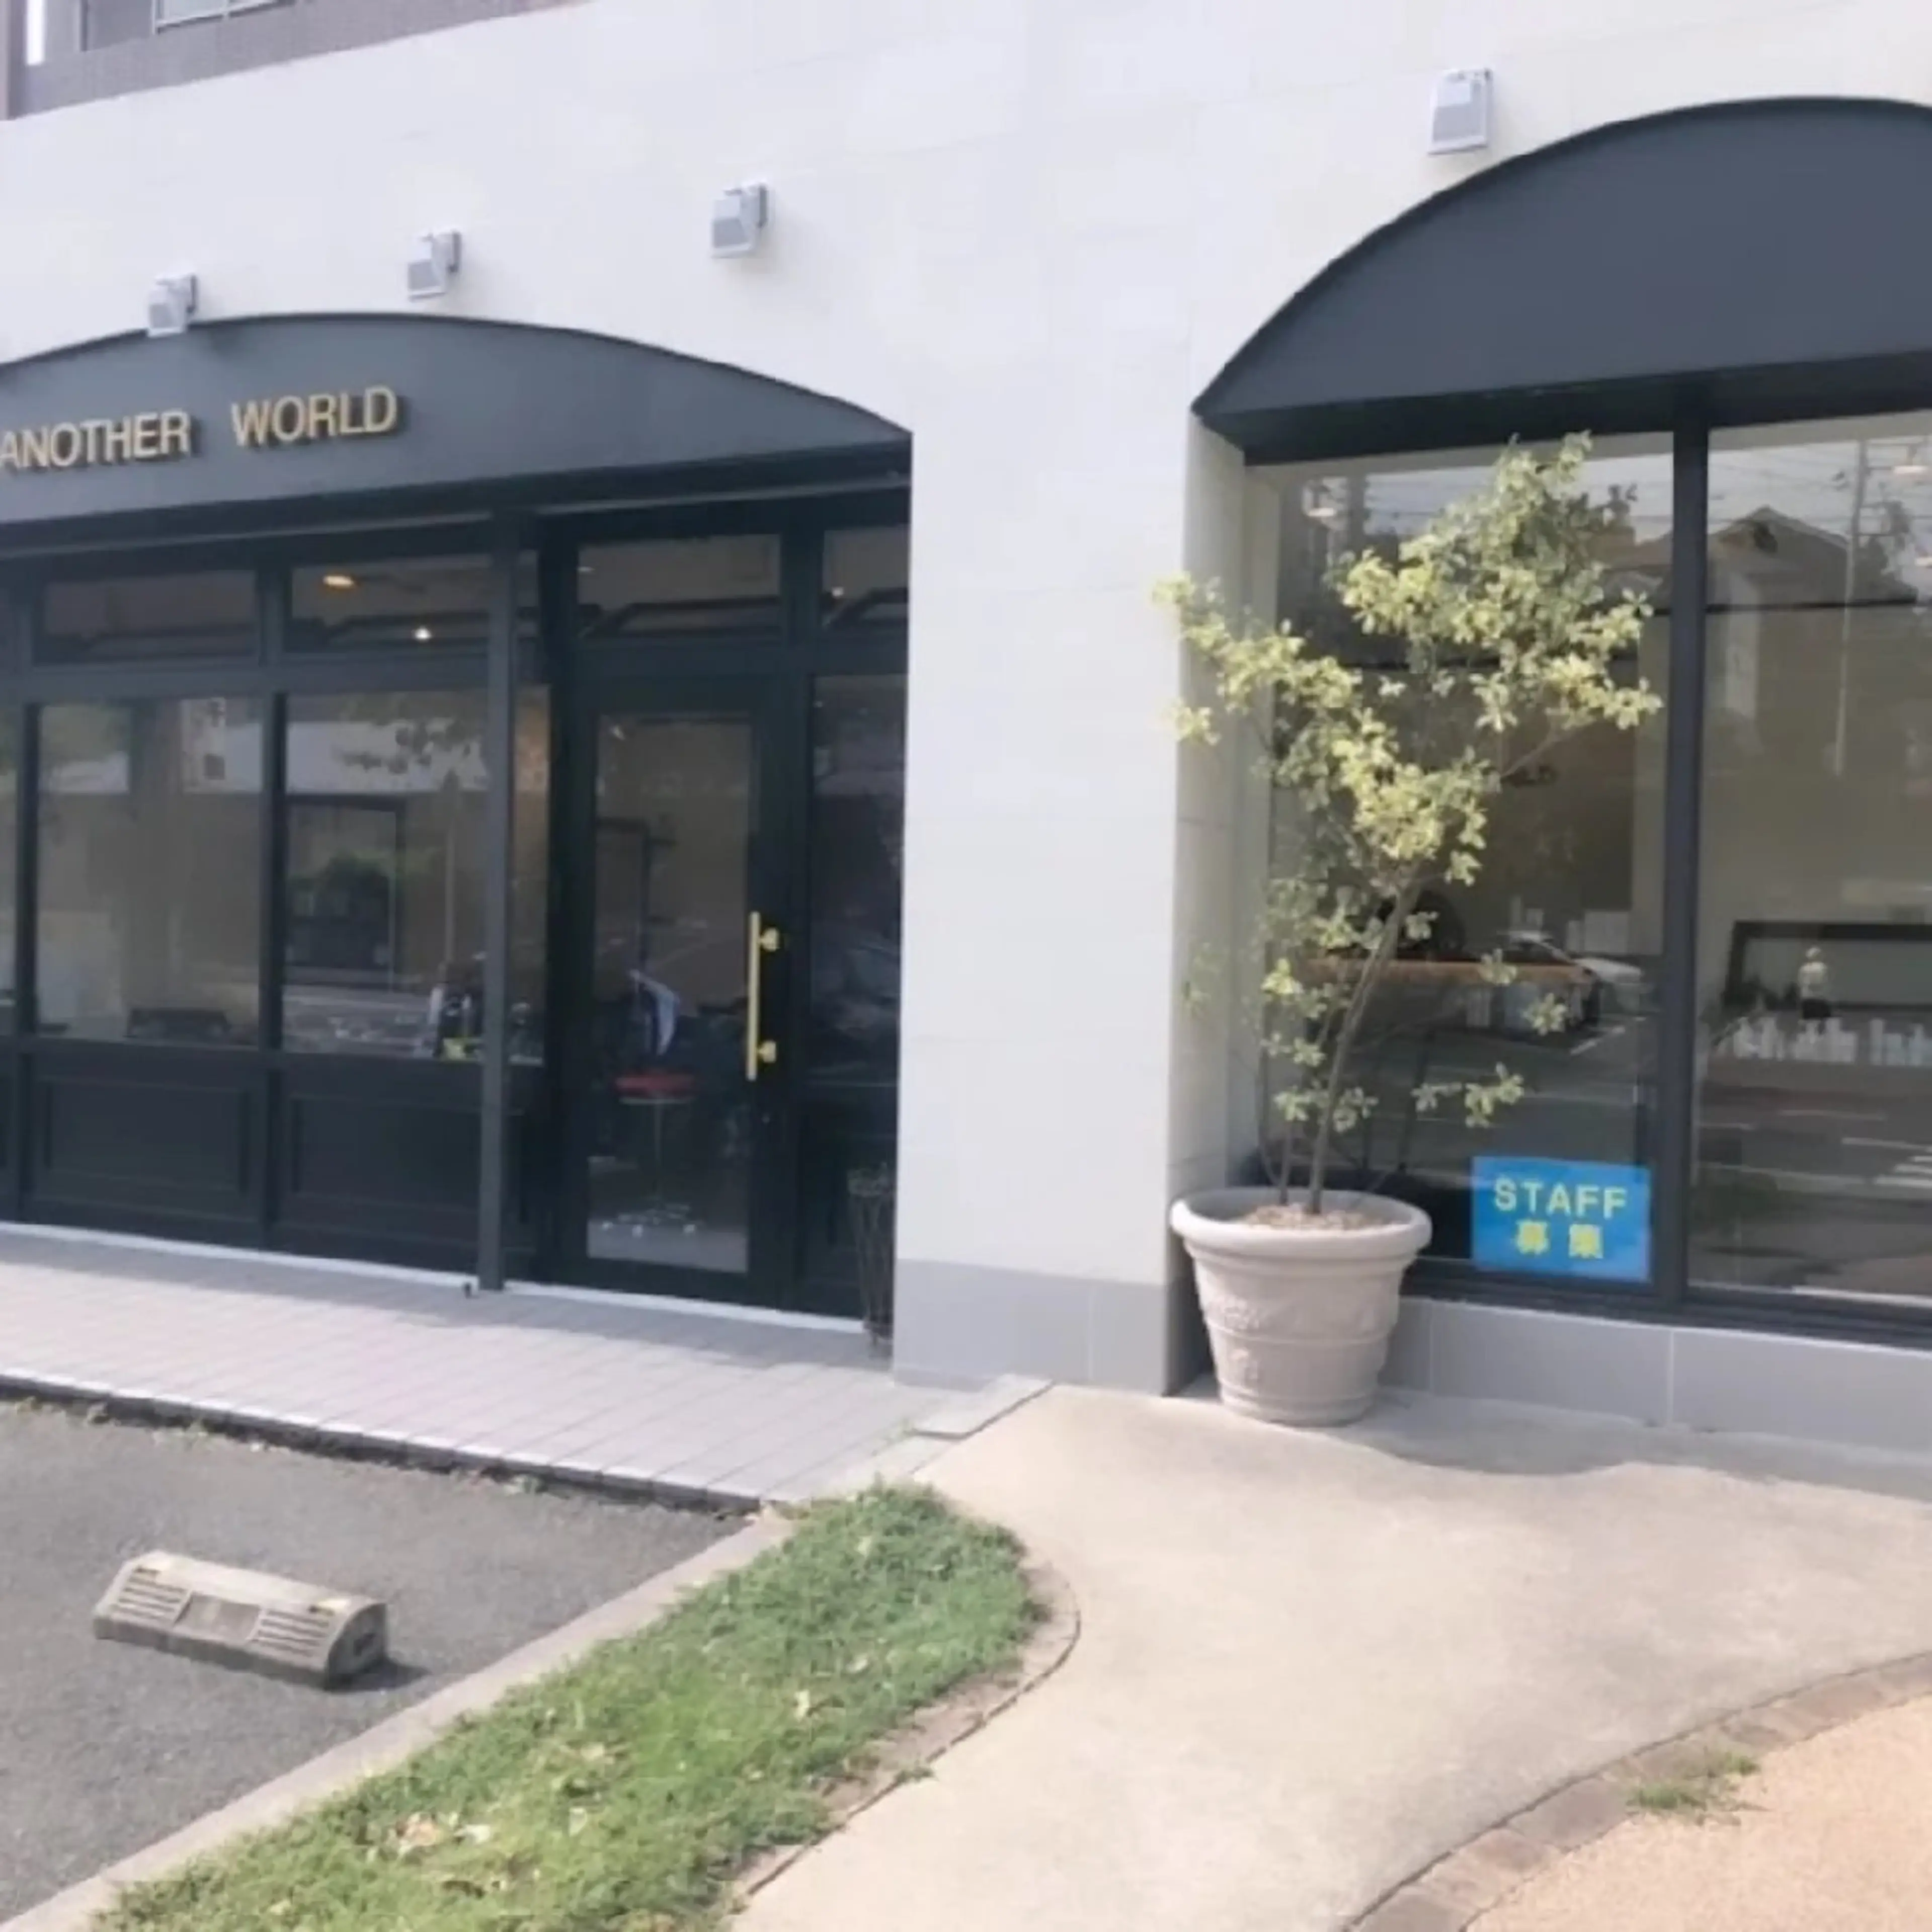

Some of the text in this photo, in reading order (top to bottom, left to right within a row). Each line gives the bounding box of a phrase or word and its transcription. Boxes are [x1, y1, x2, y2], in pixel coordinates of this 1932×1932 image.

[0, 385, 397, 468] ANOTHER WORLD
[1494, 1175, 1627, 1219] STAFF
